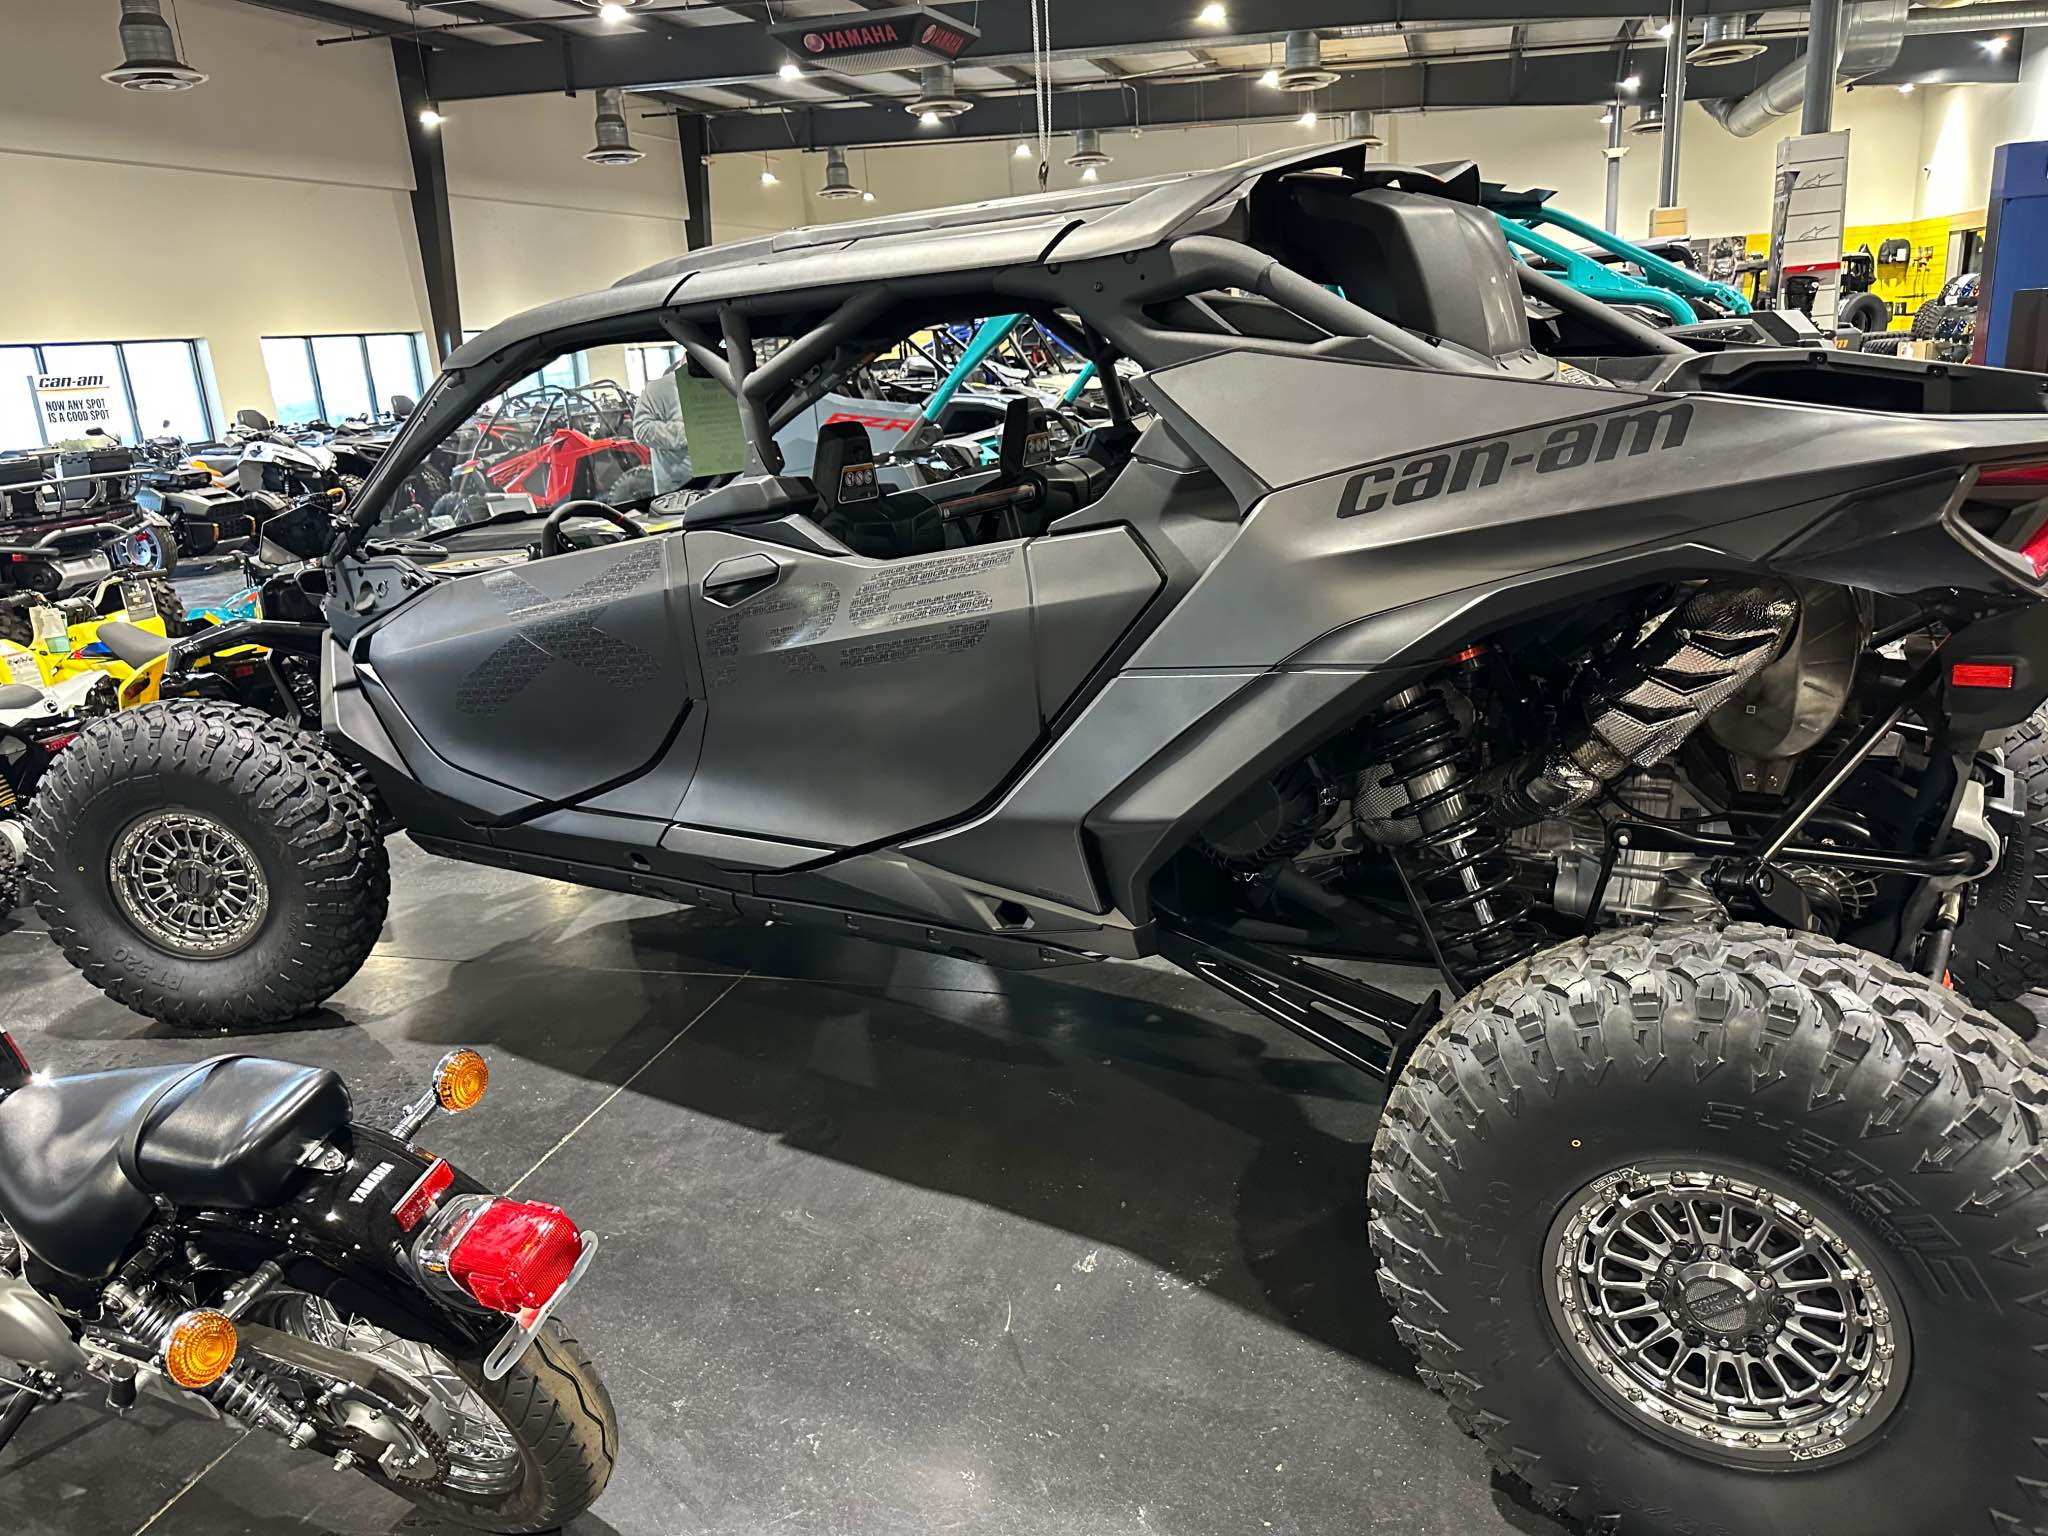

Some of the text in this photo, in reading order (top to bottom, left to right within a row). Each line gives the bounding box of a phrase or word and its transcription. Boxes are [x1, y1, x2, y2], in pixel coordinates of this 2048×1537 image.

[822, 24, 898, 49] YAMAHA
[932, 26, 965, 53] YAMAHA
[39, 375, 104, 388] can-am
[45, 398, 106, 412] NOW ANY SPOT
[48, 409, 110, 423] IS A GOOD SPOT
[1336, 402, 1694, 519] can-am
[349, 1161, 396, 1204] YAMAHA
[1592, 1165, 1641, 1191] METAL FX
[1789, 1448, 1812, 1462] FX
